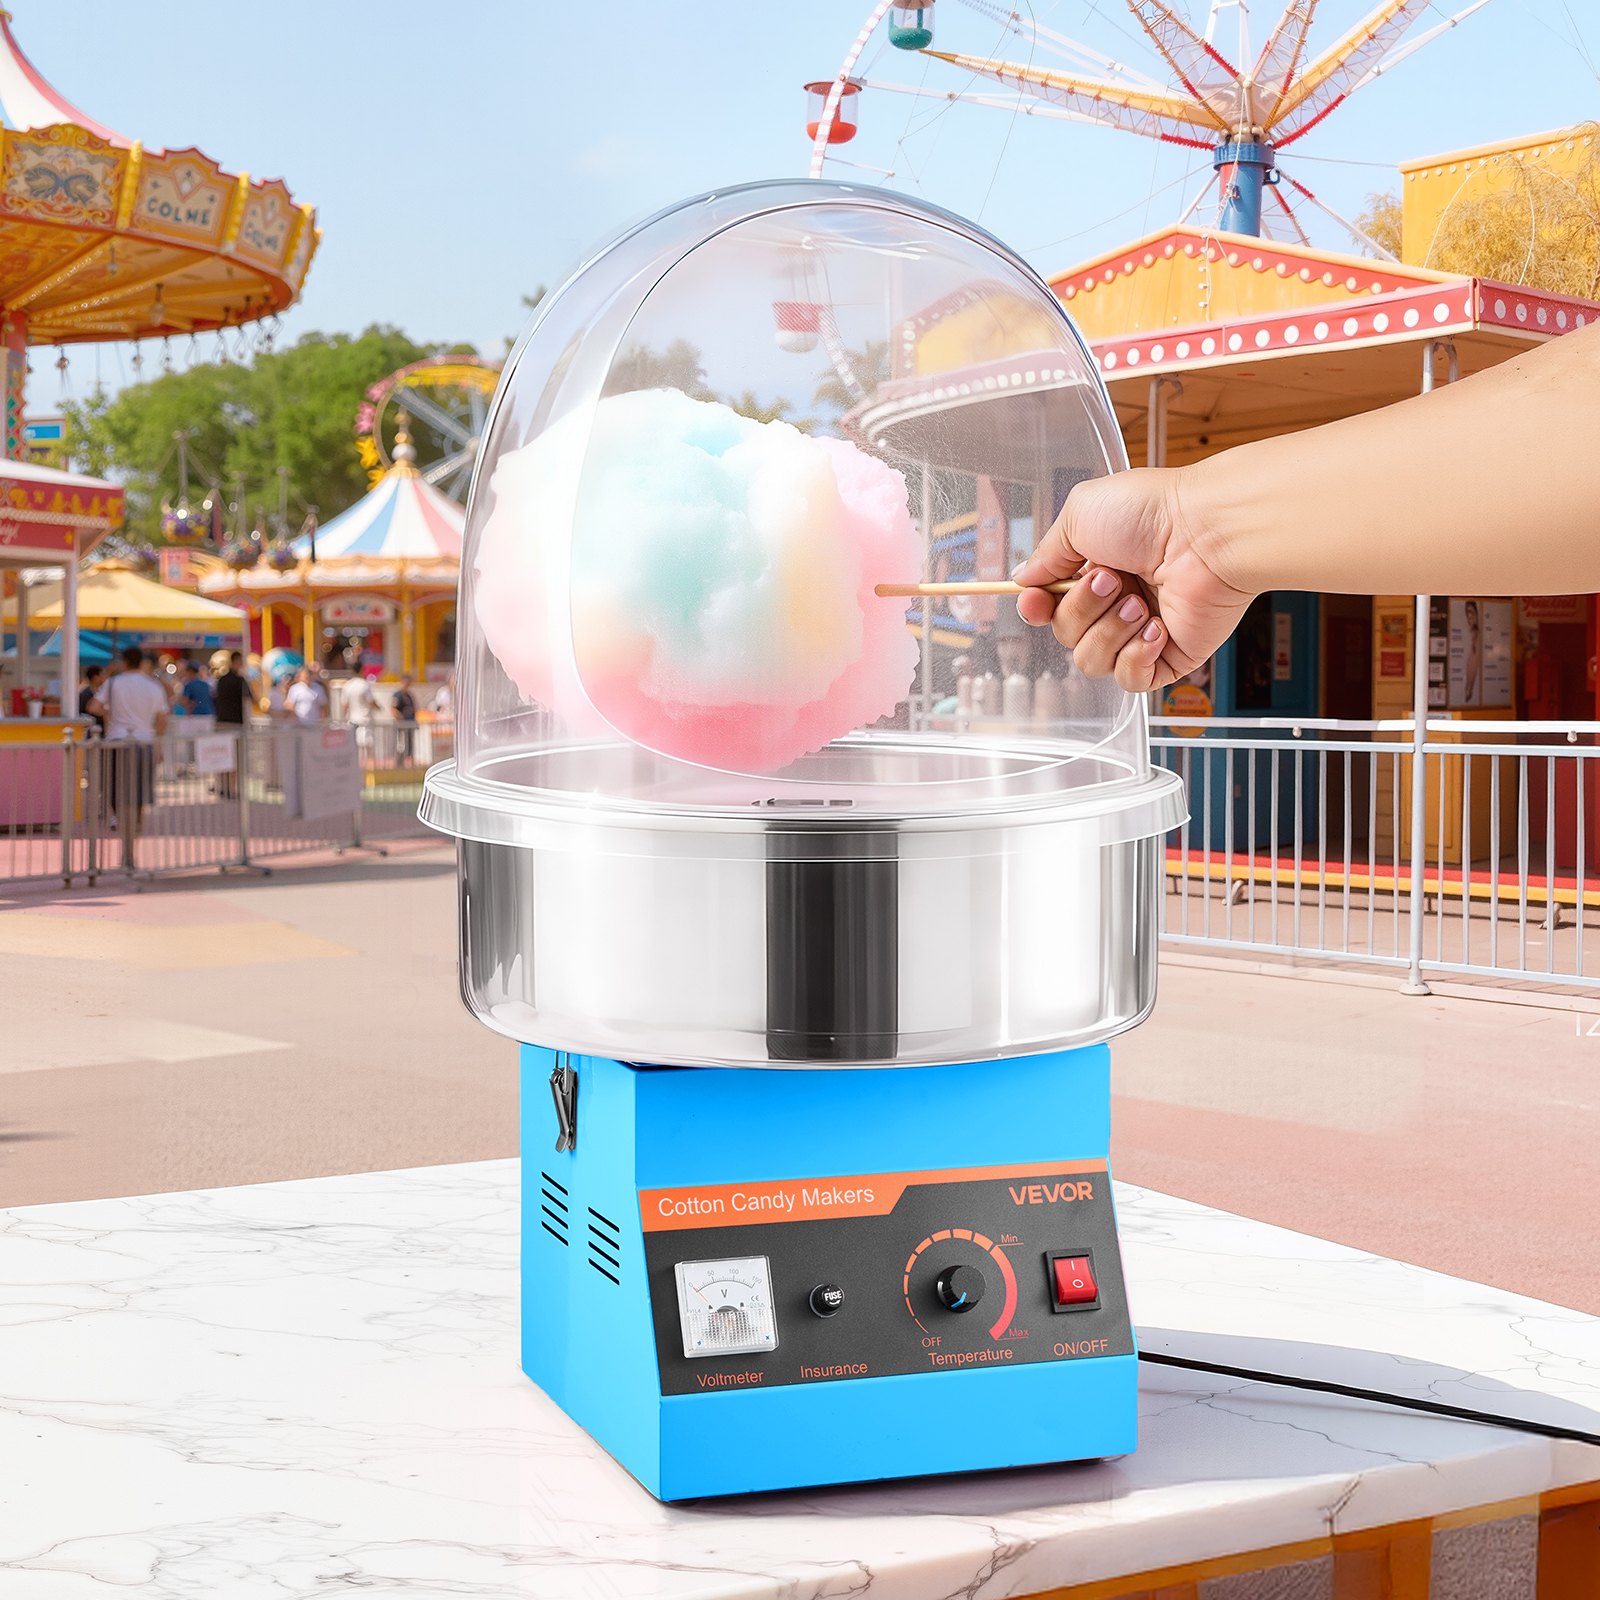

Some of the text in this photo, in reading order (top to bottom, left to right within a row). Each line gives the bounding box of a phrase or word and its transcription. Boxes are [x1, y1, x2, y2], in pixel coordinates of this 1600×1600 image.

[658, 1186, 875, 1217] Cotton Candy Makers
[1008, 1181, 1094, 1206] VEVOR
[1000, 1234, 1018, 1243] Min
[720, 1289, 728, 1298] V
[824, 1290, 843, 1301] FUSE
[1008, 1328, 1030, 1337] Max
[921, 1336, 943, 1348] OFF
[1053, 1339, 1109, 1357] ON/OFF
[928, 1348, 1014, 1367] Temperature
[696, 1370, 765, 1388] Voltmeter
[800, 1363, 869, 1379] Insurance
